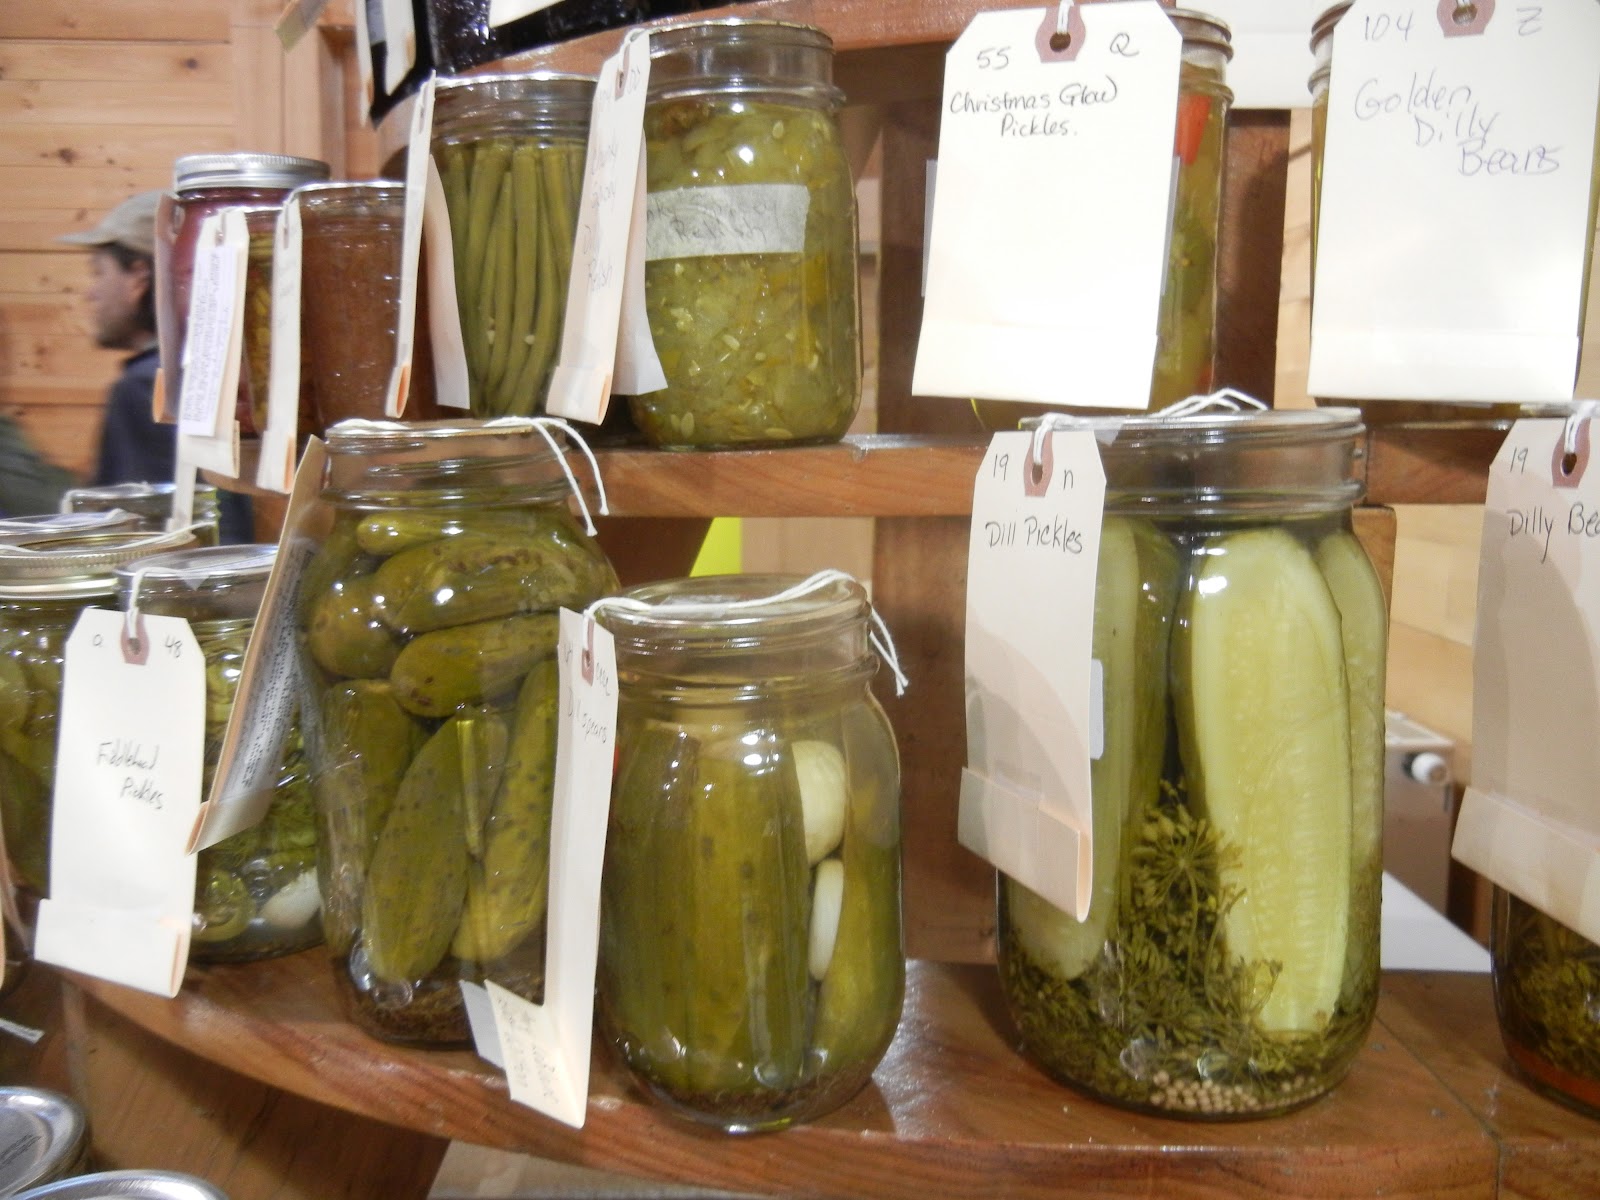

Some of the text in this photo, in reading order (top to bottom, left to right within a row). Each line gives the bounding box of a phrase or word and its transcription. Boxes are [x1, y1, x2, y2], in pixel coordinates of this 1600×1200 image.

[1365, 10, 1414, 41] 104
[977, 46, 1011, 70] 55
[1109, 32, 1140, 57] Q
[950, 90, 1051, 115] Christmas
[1354, 67, 1471, 121] Golden
[1414, 102, 1500, 149] Dilly
[992, 453, 1009, 481] 19
[1509, 447, 1529, 474] 19
[985, 514, 1083, 554] Dill Pickles
[1506, 506, 1554, 564] Dilly
